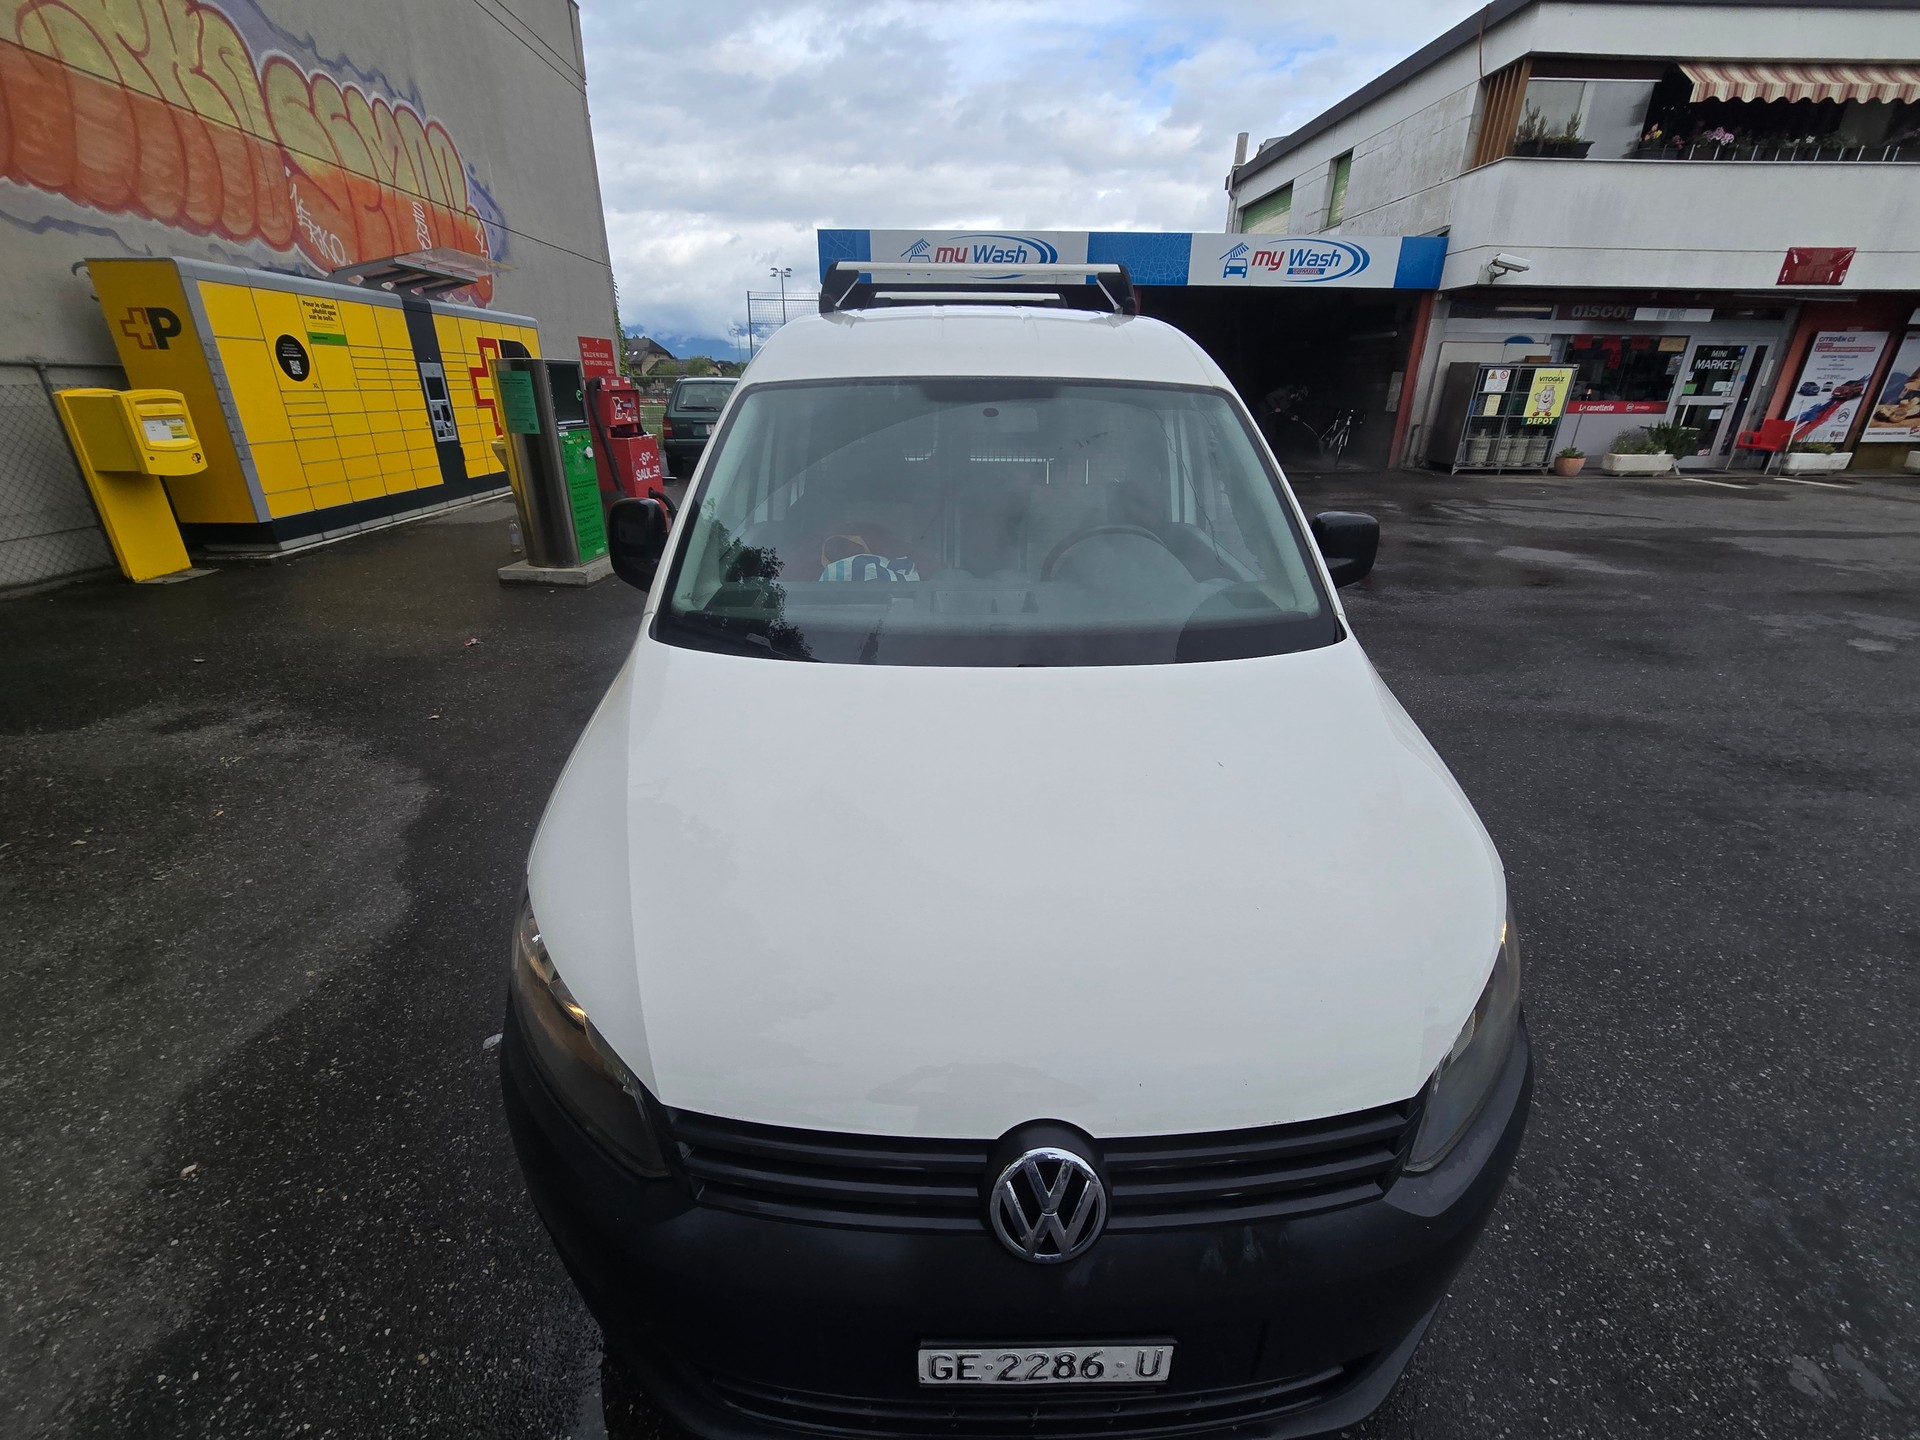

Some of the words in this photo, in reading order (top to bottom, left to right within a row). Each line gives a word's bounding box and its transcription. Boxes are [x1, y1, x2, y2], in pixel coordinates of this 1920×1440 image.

[973, 244, 1028, 263] Wash
[1251, 250, 1286, 271] my
[1289, 248, 1342, 267] Wash
[144, 307, 182, 350] P
[1695, 360, 1736, 369] MARKET
[928, 1352, 982, 1381] GE
[996, 1349, 1105, 1382] 2286
[1134, 1349, 1164, 1378] U
